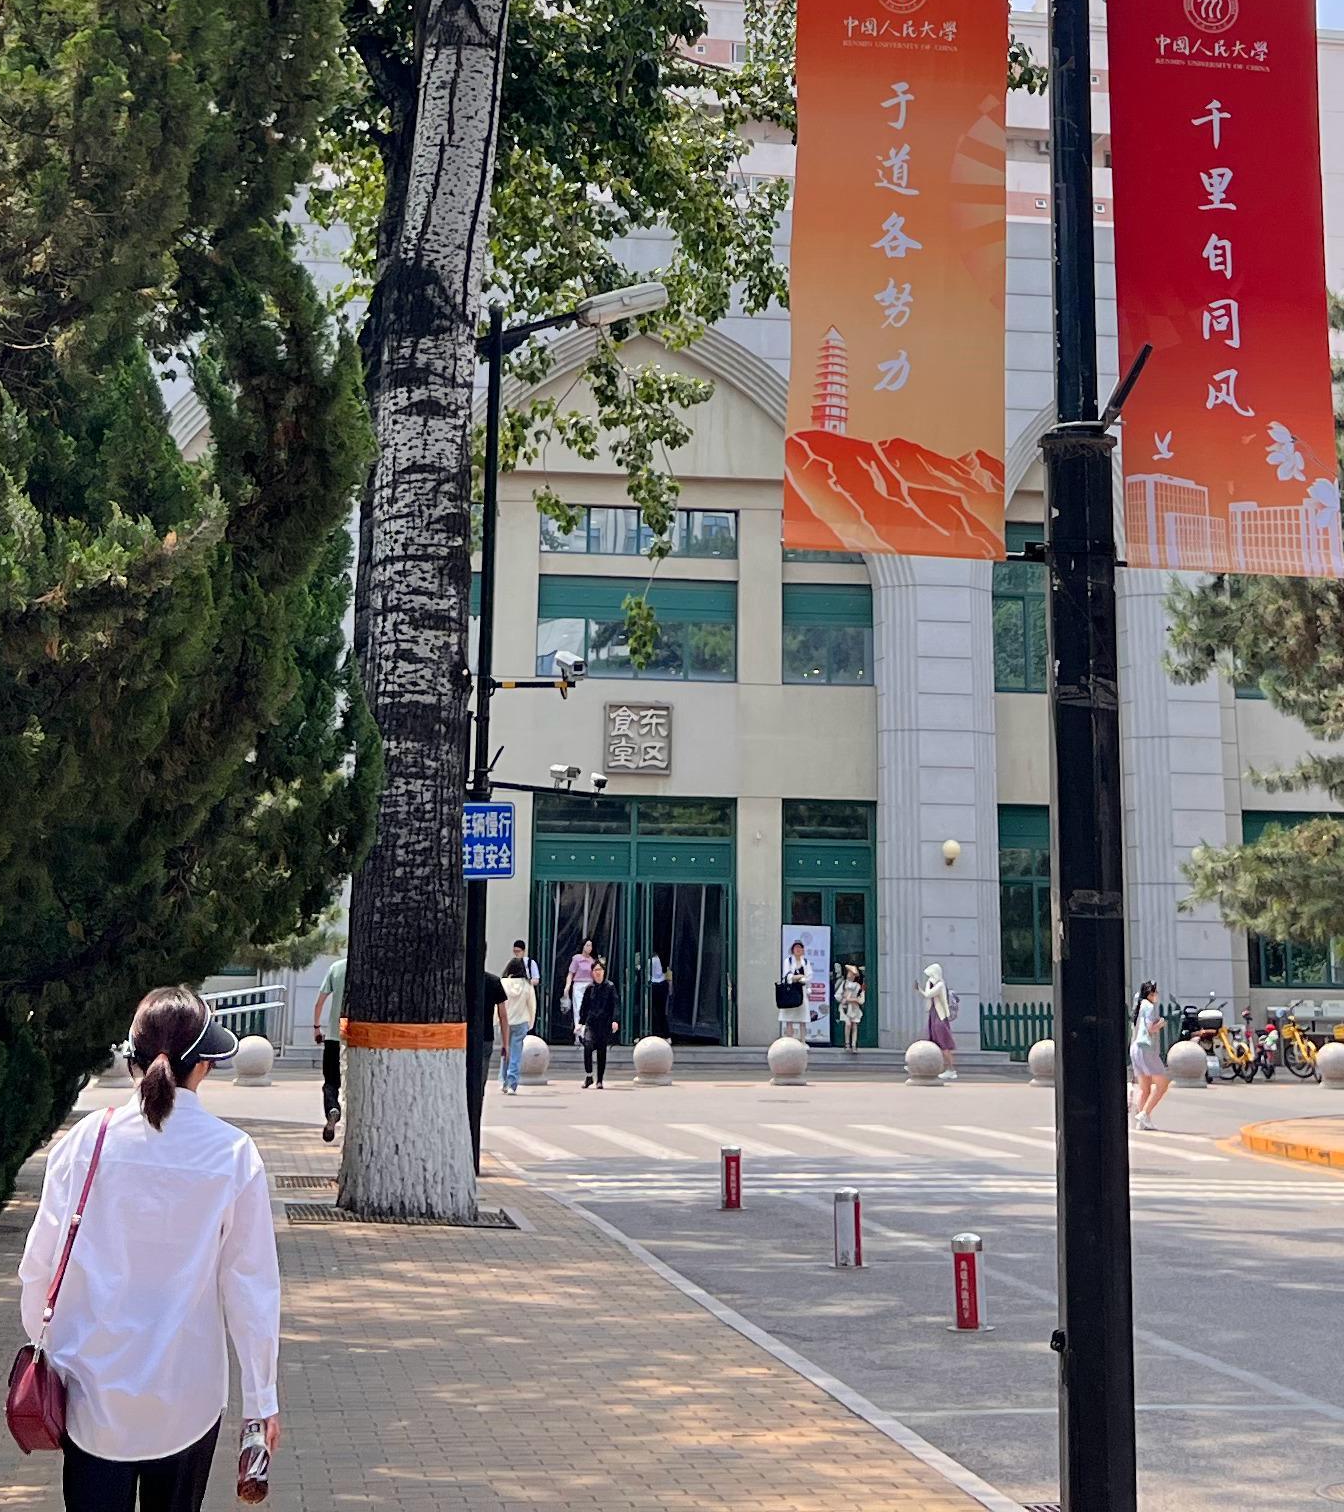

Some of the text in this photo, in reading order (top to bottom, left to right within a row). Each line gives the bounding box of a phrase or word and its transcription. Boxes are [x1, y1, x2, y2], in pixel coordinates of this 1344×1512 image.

[843, 16, 957, 42] 中國人民大學
[1155, 34, 1269, 62] 中國人民大學
[1191, 99, 1255, 417] 千里自同风
